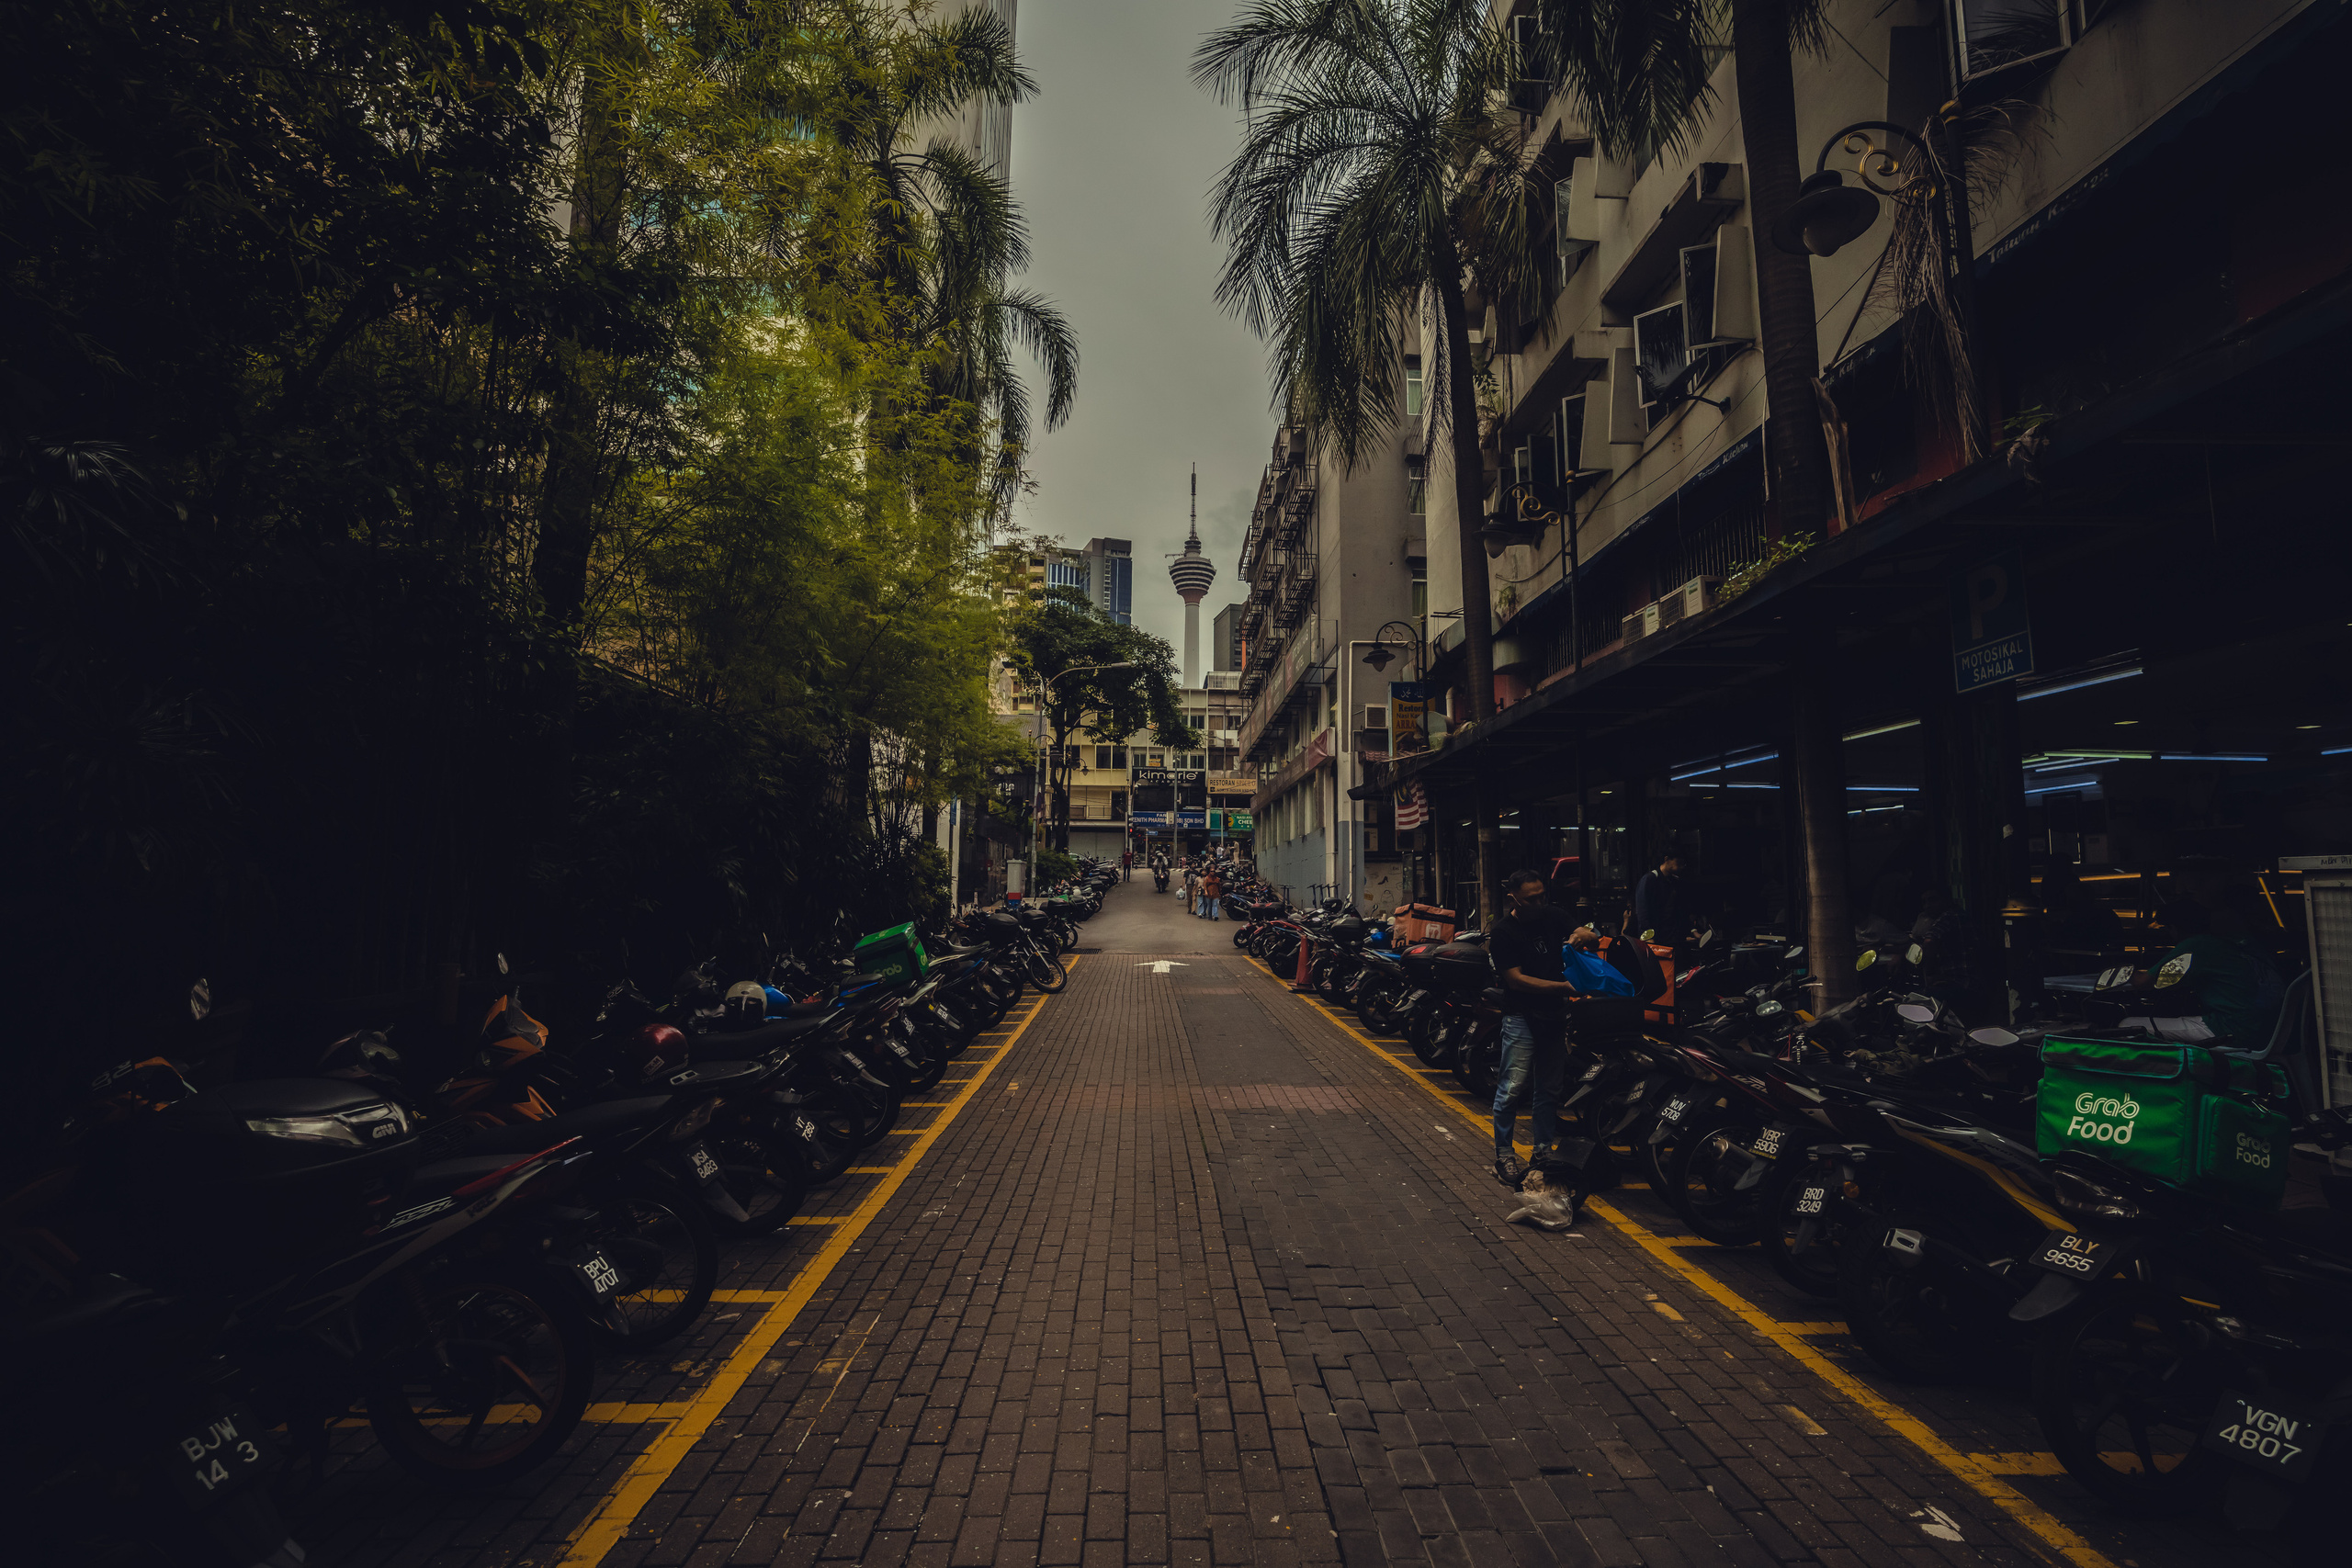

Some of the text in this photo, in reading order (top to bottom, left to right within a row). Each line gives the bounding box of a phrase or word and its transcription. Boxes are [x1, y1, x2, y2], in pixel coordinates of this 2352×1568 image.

[1966, 564, 2008, 640] P
[1962, 639, 2024, 671] MOTOSIKAL
[1973, 658, 2015, 682] SAHAJA
[1661, 1107, 1681, 1121] 5708
[2075, 1092, 2140, 1119] Grab
[795, 1116, 806, 1129] VT
[801, 1121, 815, 1142] 7360
[2067, 1116, 2135, 1145] Food
[1754, 1138, 1779, 1154] 5906
[1762, 1128, 1781, 1143] VBR
[2235, 1132, 2272, 1154] Grab
[691, 1149, 710, 1167] WSA
[696, 1159, 718, 1179] 8483
[2235, 1147, 2271, 1169] Food
[1803, 1188, 1825, 1201] BRD
[1796, 1200, 1823, 1213] 3249
[2059, 1235, 2101, 1256] BLY
[582, 1256, 609, 1280] BPU
[2043, 1249, 2096, 1272] 9655
[593, 1268, 620, 1294] 4707
[2245, 1405, 2300, 1441] VGN
[180, 1416, 238, 1463] BJW
[2219, 1424, 2303, 1465] 4807
